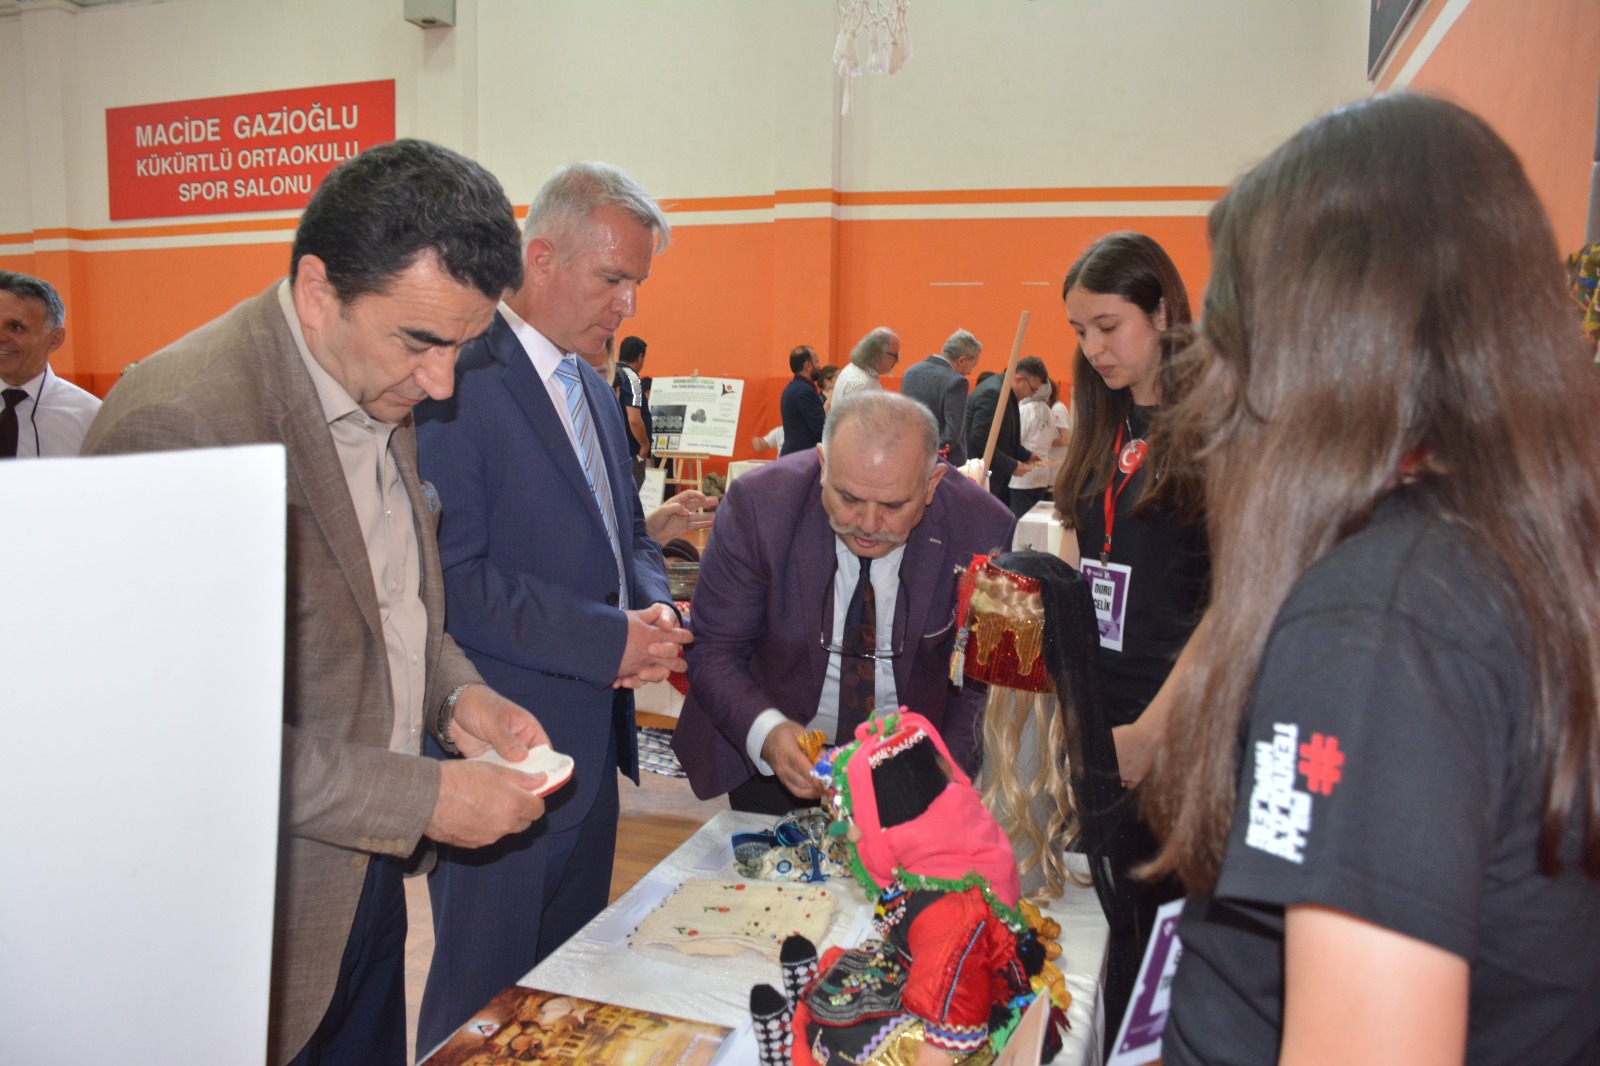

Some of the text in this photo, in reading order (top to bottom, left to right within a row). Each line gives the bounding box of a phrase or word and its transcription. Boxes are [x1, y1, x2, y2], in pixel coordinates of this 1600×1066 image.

[135, 102, 359, 147] MACİDE GAZİOĞLU
[136, 141, 359, 177] KÜKÜRTLÜ ORTAOKULU
[178, 174, 312, 201] SPOR SALONU
[1094, 583, 1113, 597] DURU
